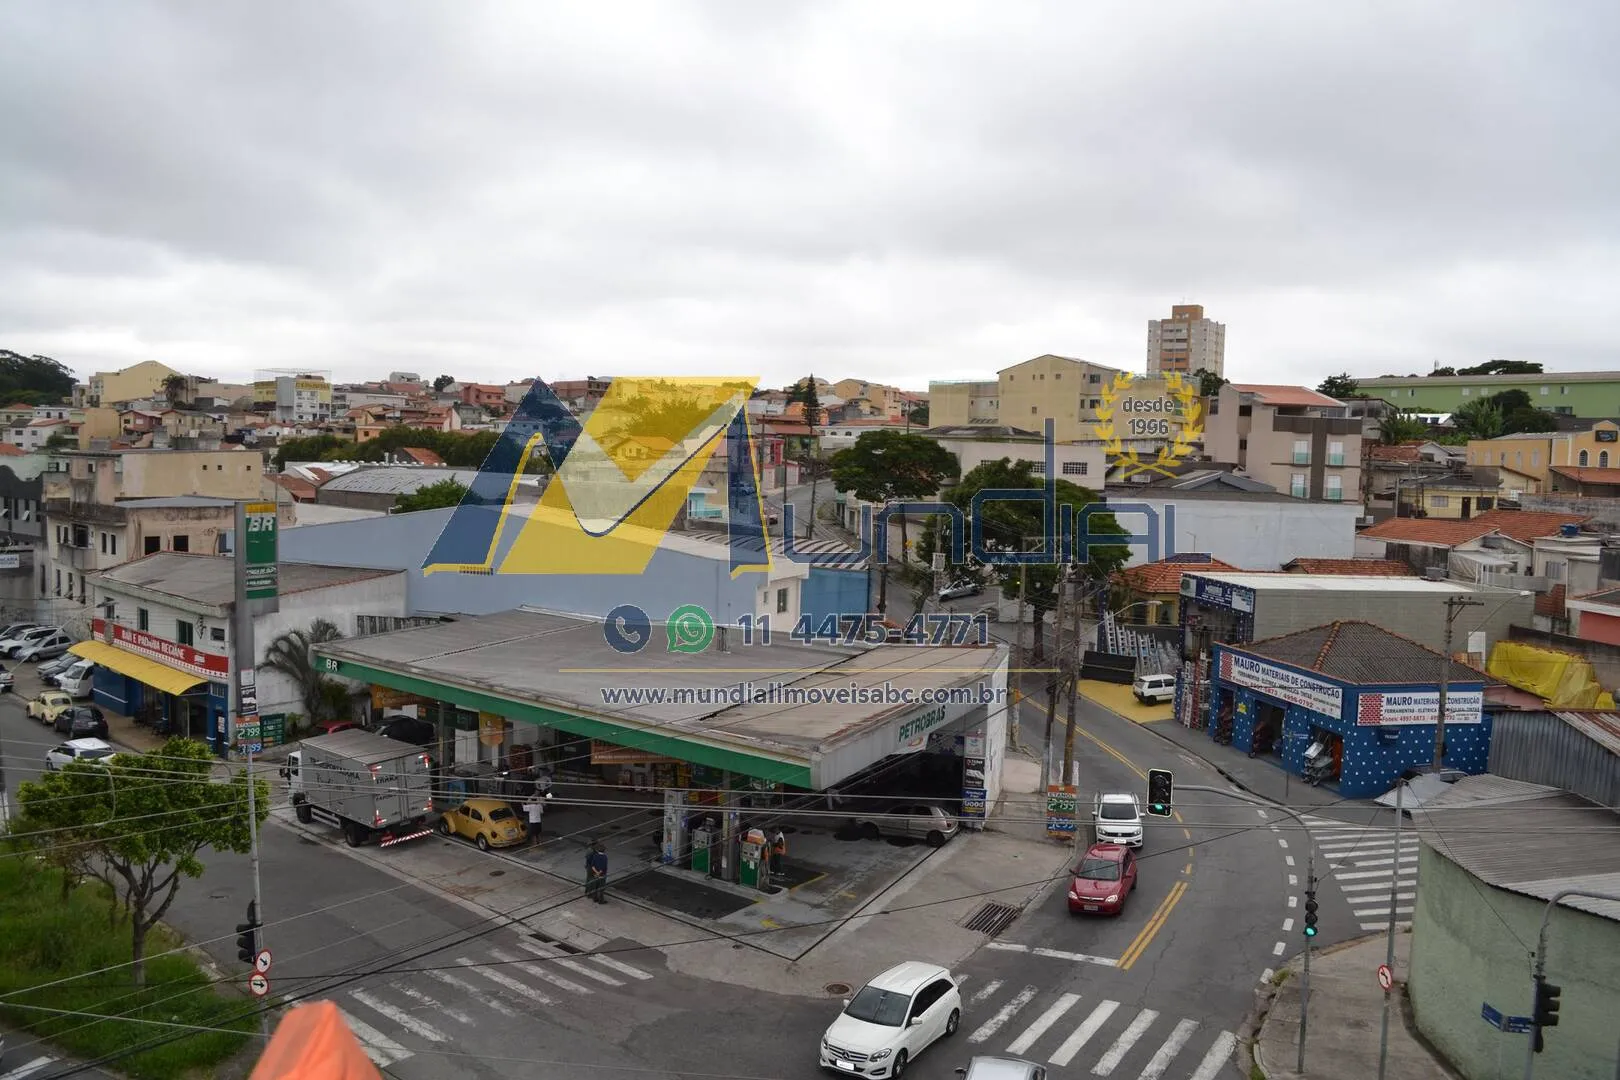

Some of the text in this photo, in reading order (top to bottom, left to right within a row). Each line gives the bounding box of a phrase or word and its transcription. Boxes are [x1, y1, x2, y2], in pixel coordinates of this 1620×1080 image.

[247, 516, 274, 532] BR
[326, 658, 338, 672] BR
[1233, 656, 1261, 674] MAURO
[1261, 666, 1290, 683] MATERIAIS
[1291, 677, 1299, 686] DE
[1385, 696, 1413, 706] MAURO
[1413, 697, 1440, 705] MATERIAIS
[897, 704, 946, 743] PETROBRAS
